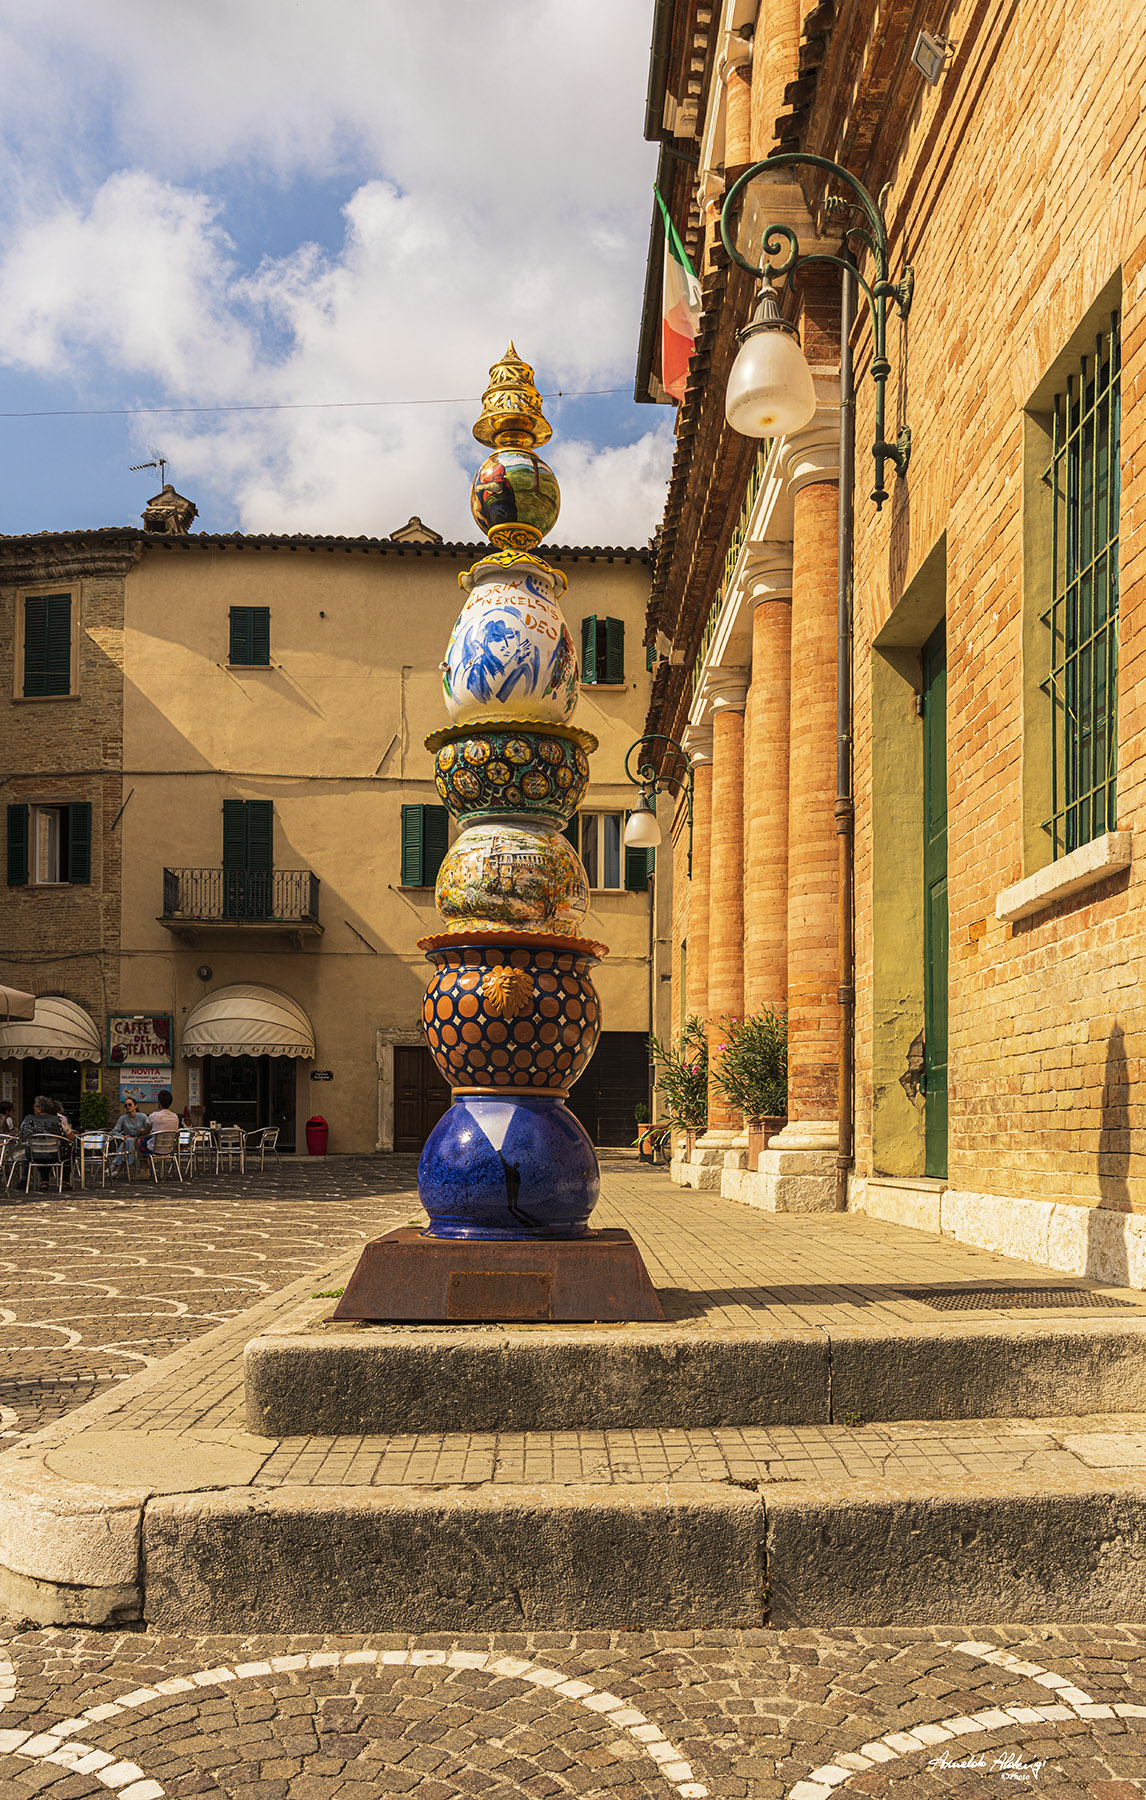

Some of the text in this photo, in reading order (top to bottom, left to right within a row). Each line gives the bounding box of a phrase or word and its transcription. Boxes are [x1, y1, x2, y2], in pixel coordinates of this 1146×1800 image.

[481, 596, 559, 620] IN EXCELSIS
[525, 613, 558, 641] DEO
[37, 1048, 90, 1058] TEATRO
[128, 1043, 165, 1056] TEATRO
[251, 1046, 313, 1055] GELATERIA
